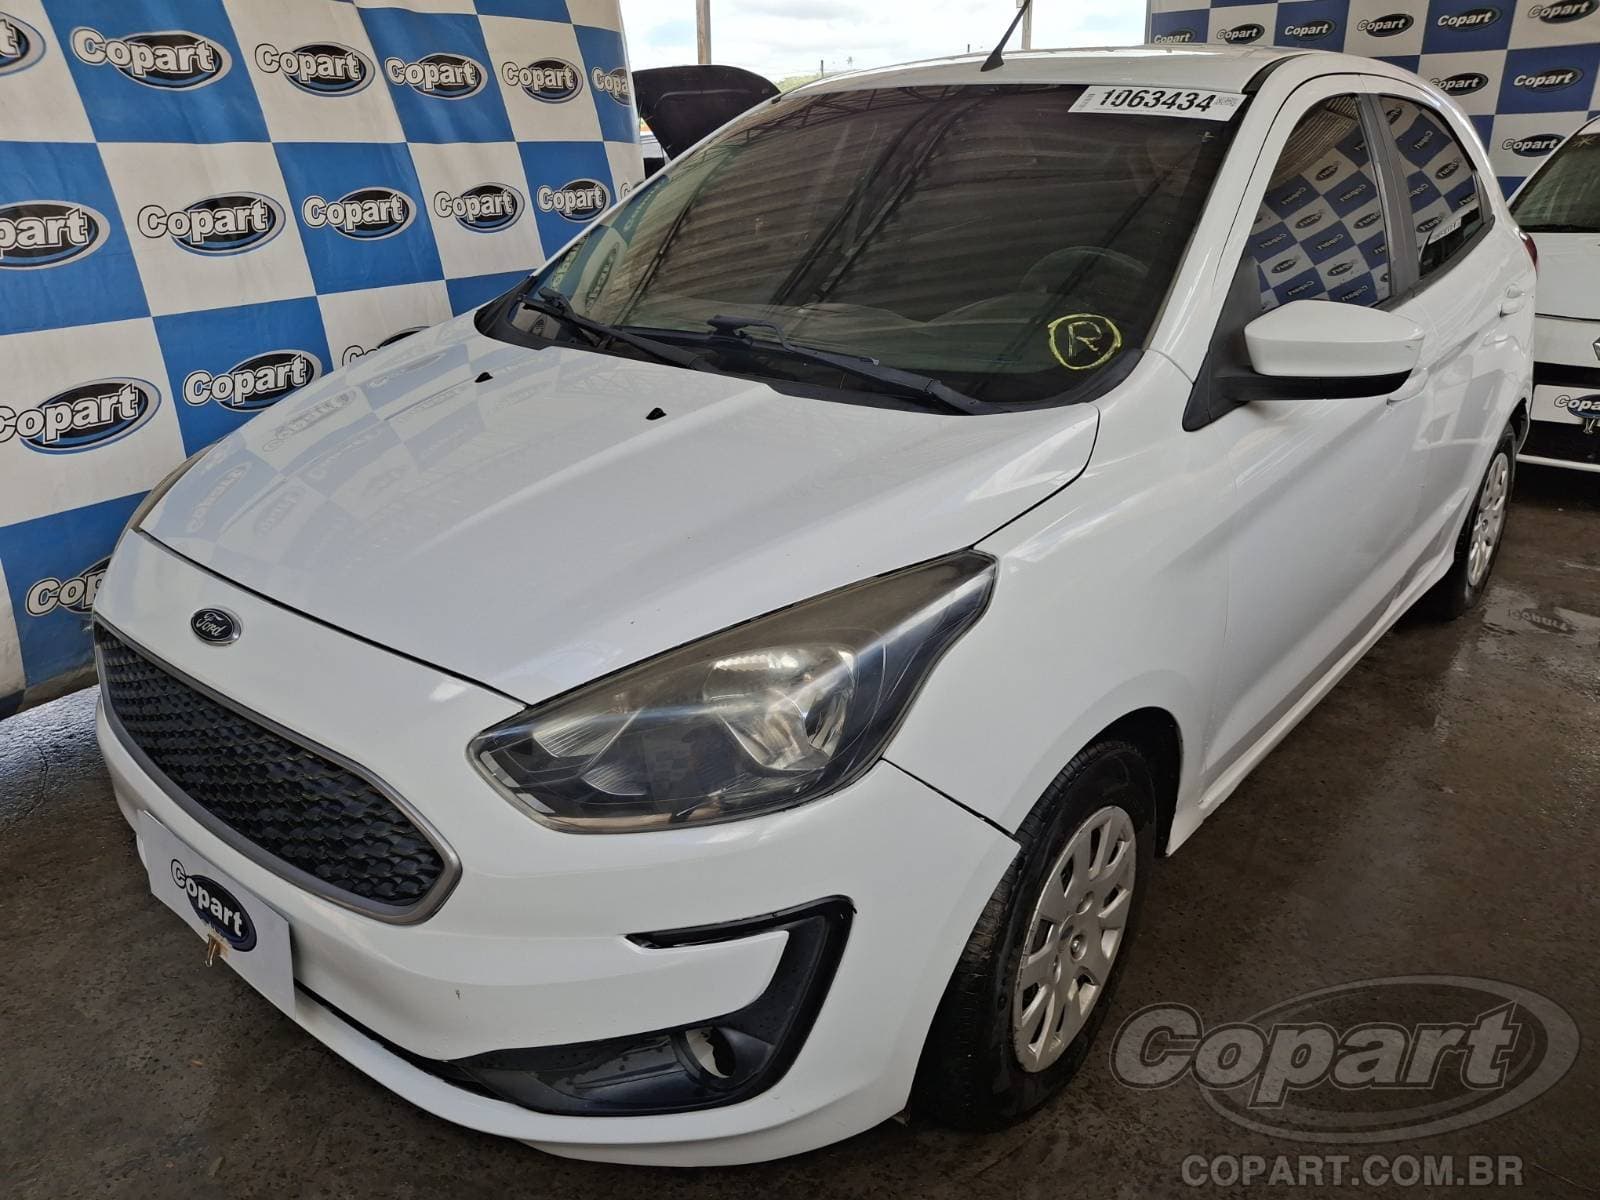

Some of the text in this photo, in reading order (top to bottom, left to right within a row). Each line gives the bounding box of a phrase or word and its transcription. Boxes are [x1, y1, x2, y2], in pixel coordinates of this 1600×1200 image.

[1437, 11, 1493, 26] Copart
[1527, 0, 1590, 18] Copart
[1217, 28, 1258, 40] Copart
[1284, 23, 1329, 36] Copart
[1357, 17, 1406, 31] Copart
[71, 27, 216, 77] Copart
[255, 43, 361, 84] Copart
[385, 58, 478, 91] Copart
[502, 61, 574, 90] Copart
[1513, 72, 1574, 88] Copart
[1099, 89, 1218, 112] 1063434
[1502, 138, 1558, 153] Copart
[433, 188, 515, 224] Copart
[537, 178, 604, 214] Copart
[137, 199, 268, 244] Copart
[302, 194, 404, 232] Copart
[183, 353, 308, 406] Copart
[196, 612, 227, 637] Ford
[171, 858, 243, 937] Copart
